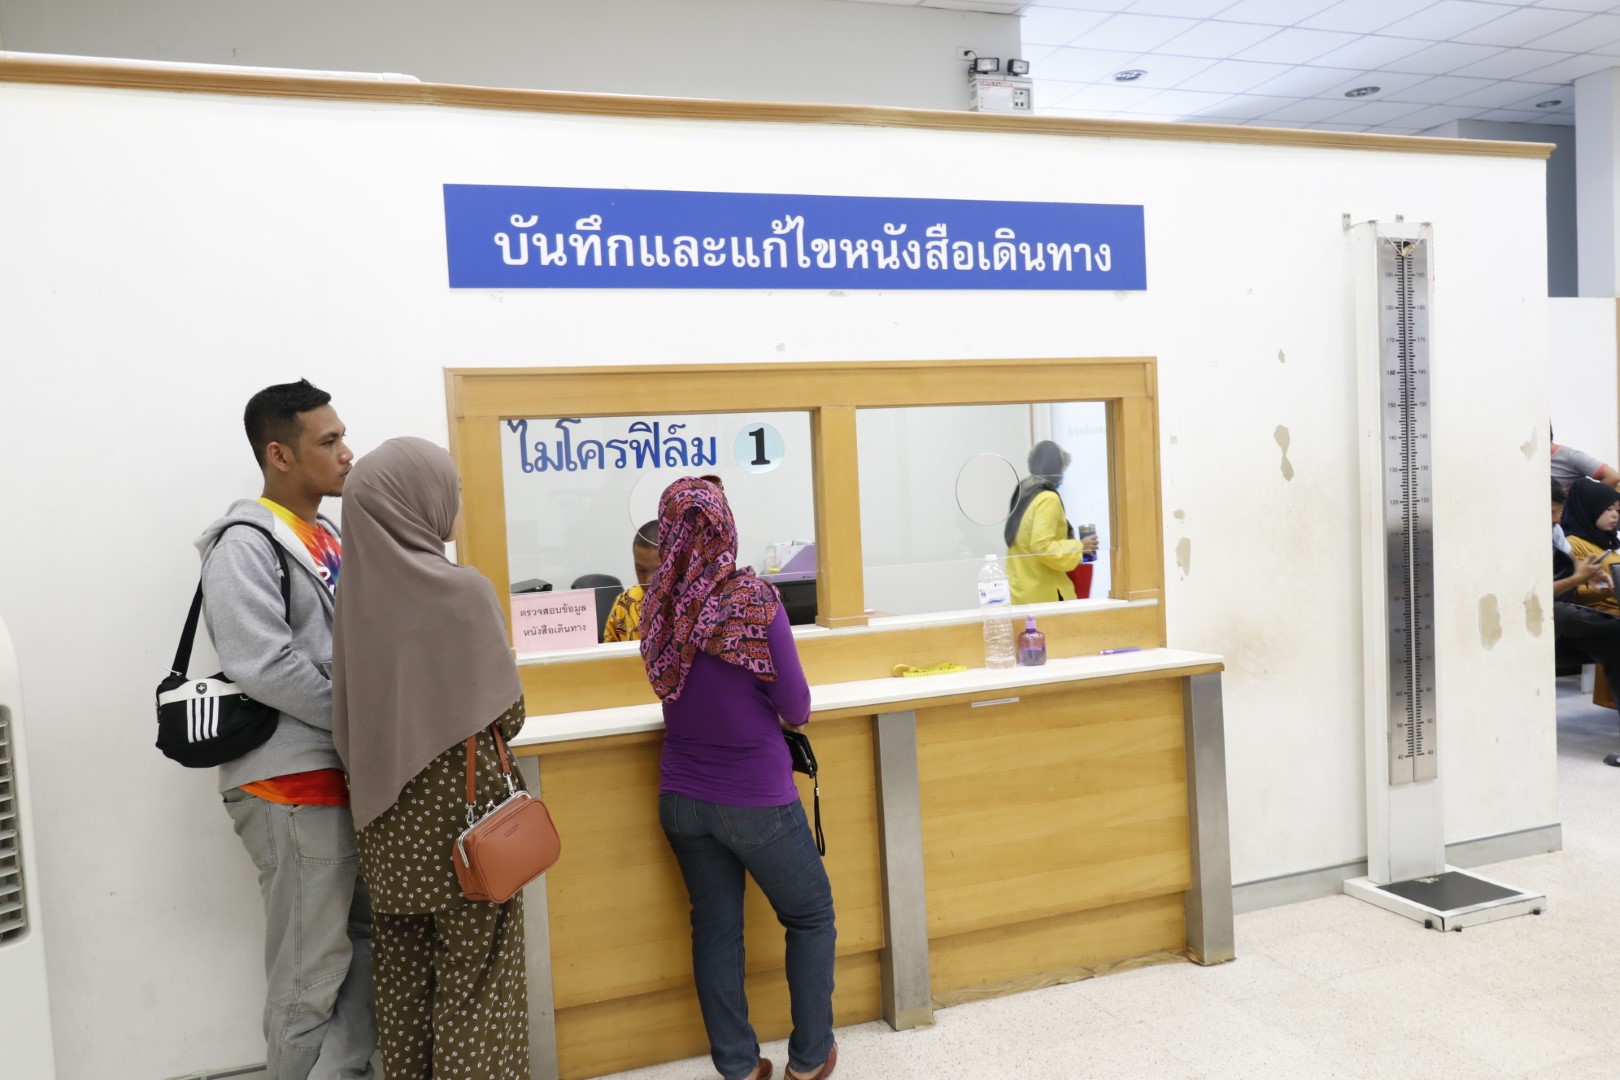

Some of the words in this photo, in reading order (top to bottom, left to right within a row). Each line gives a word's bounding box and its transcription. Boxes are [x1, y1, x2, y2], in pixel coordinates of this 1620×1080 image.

[494, 213, 1112, 272] บันทึกและแก้ไขหนังสือเดินทาง
[507, 418, 717, 474] ไมโครฟิล์ม
[749, 427, 771, 466] 1
[520, 603, 587, 617] ตรวจสอบข้อมูล
[523, 624, 587, 637] หนังสือเดินทาง
